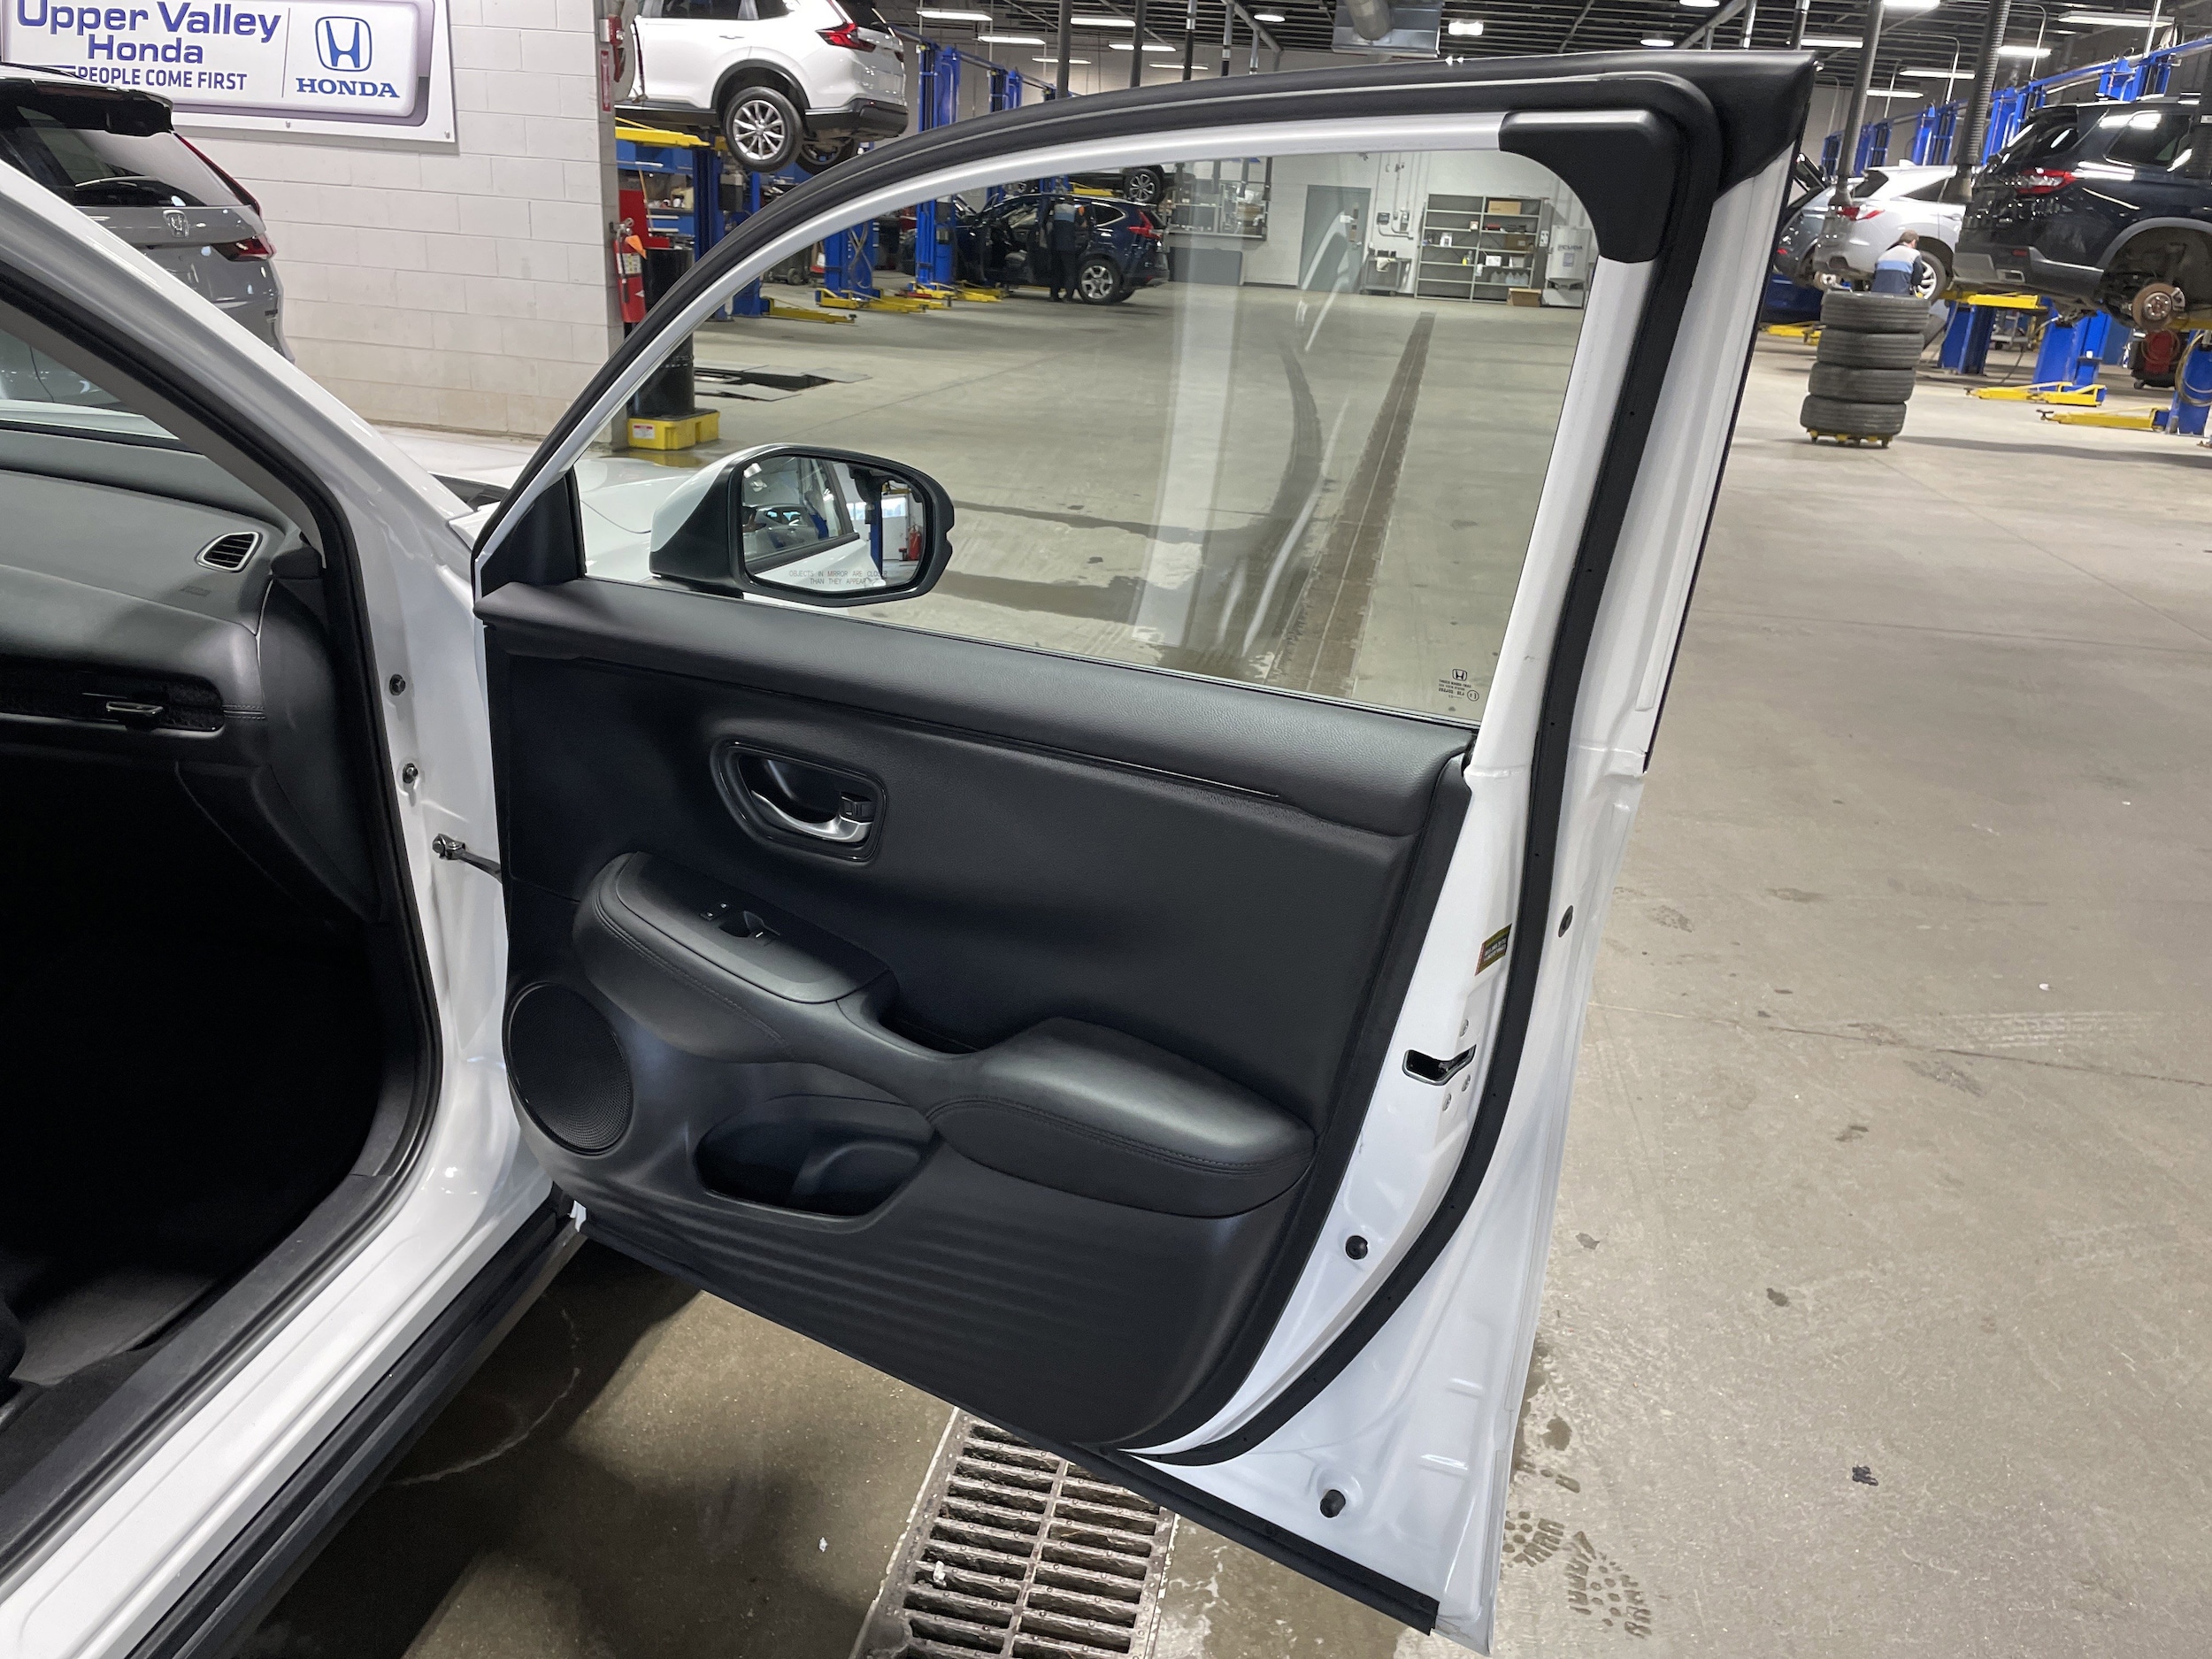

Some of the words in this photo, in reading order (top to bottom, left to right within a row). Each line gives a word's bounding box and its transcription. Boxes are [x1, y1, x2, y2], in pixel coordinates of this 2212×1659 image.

[18, 0, 149, 35] Upper
[157, 1, 281, 42] Valley
[88, 34, 203, 64] Honda
[78, 66, 141, 85] PEOPLE
[146, 69, 192, 87] COME
[198, 72, 247, 90] FIRST
[296, 78, 400, 98] HONDA
